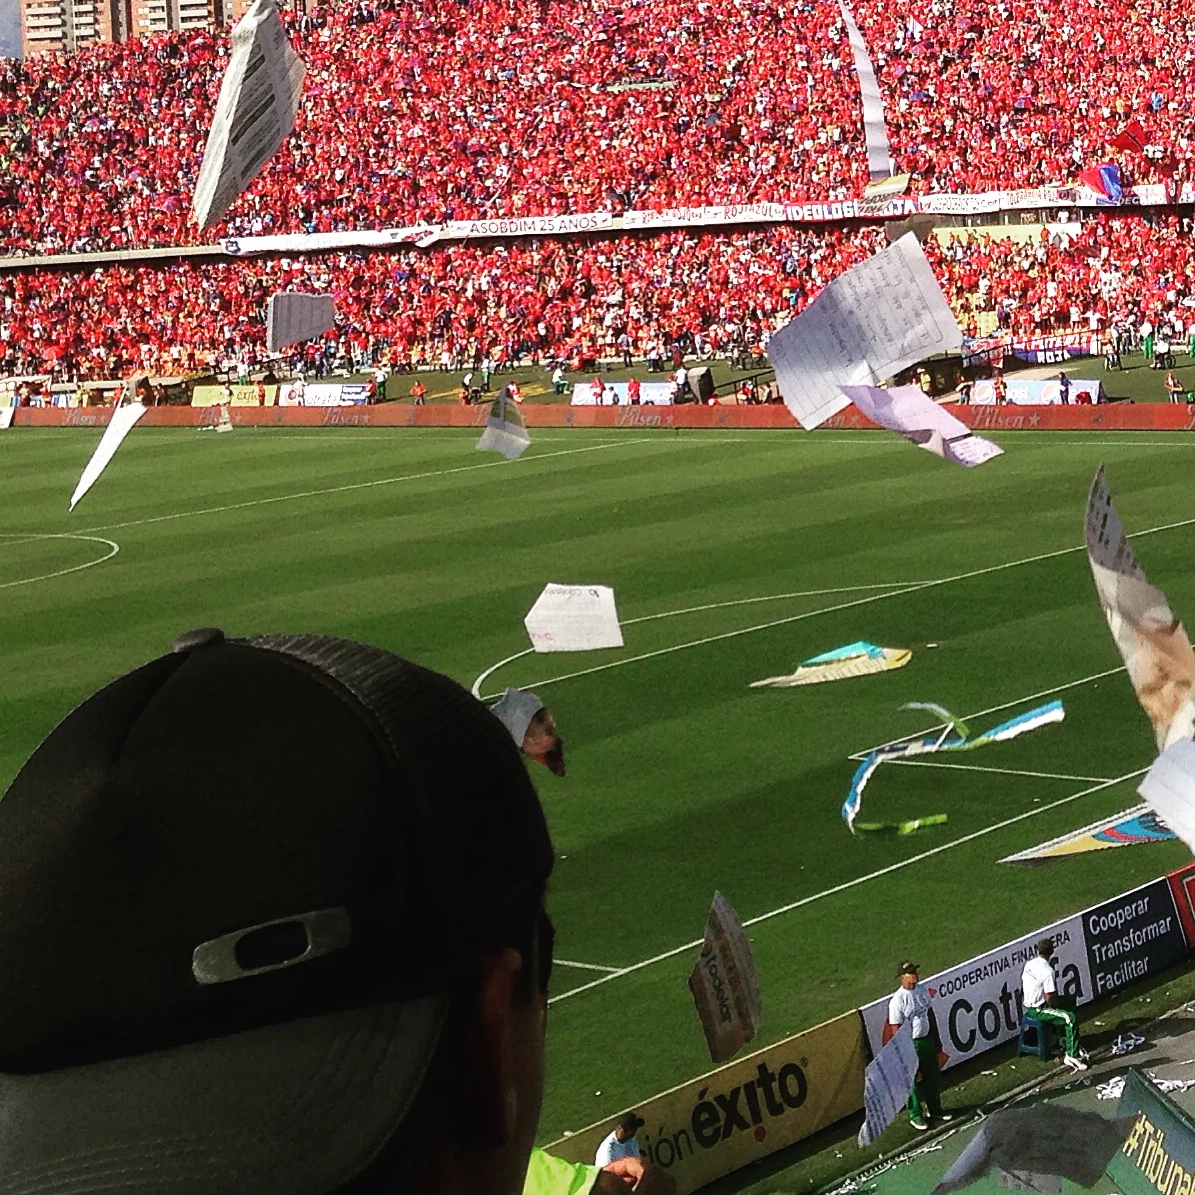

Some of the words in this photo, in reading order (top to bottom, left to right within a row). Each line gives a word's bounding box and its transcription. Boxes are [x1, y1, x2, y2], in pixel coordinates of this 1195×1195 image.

[470, 218, 536, 234] ASOBDIM
[540, 219, 555, 231] 25
[786, 203, 858, 222] IDEOLOGI
[619, 405, 662, 426] Pilsen
[971, 405, 1025, 429] Pilsen
[1089, 896, 1150, 936] Cooperar
[1092, 916, 1173, 965] Transformar
[938, 953, 1011, 998] COOPERATIVA
[1012, 930, 1071, 965] FINANERA
[1096, 956, 1149, 994] Facilitar
[640, 1125, 693, 1168] ión
[691, 1062, 808, 1149] éxito
